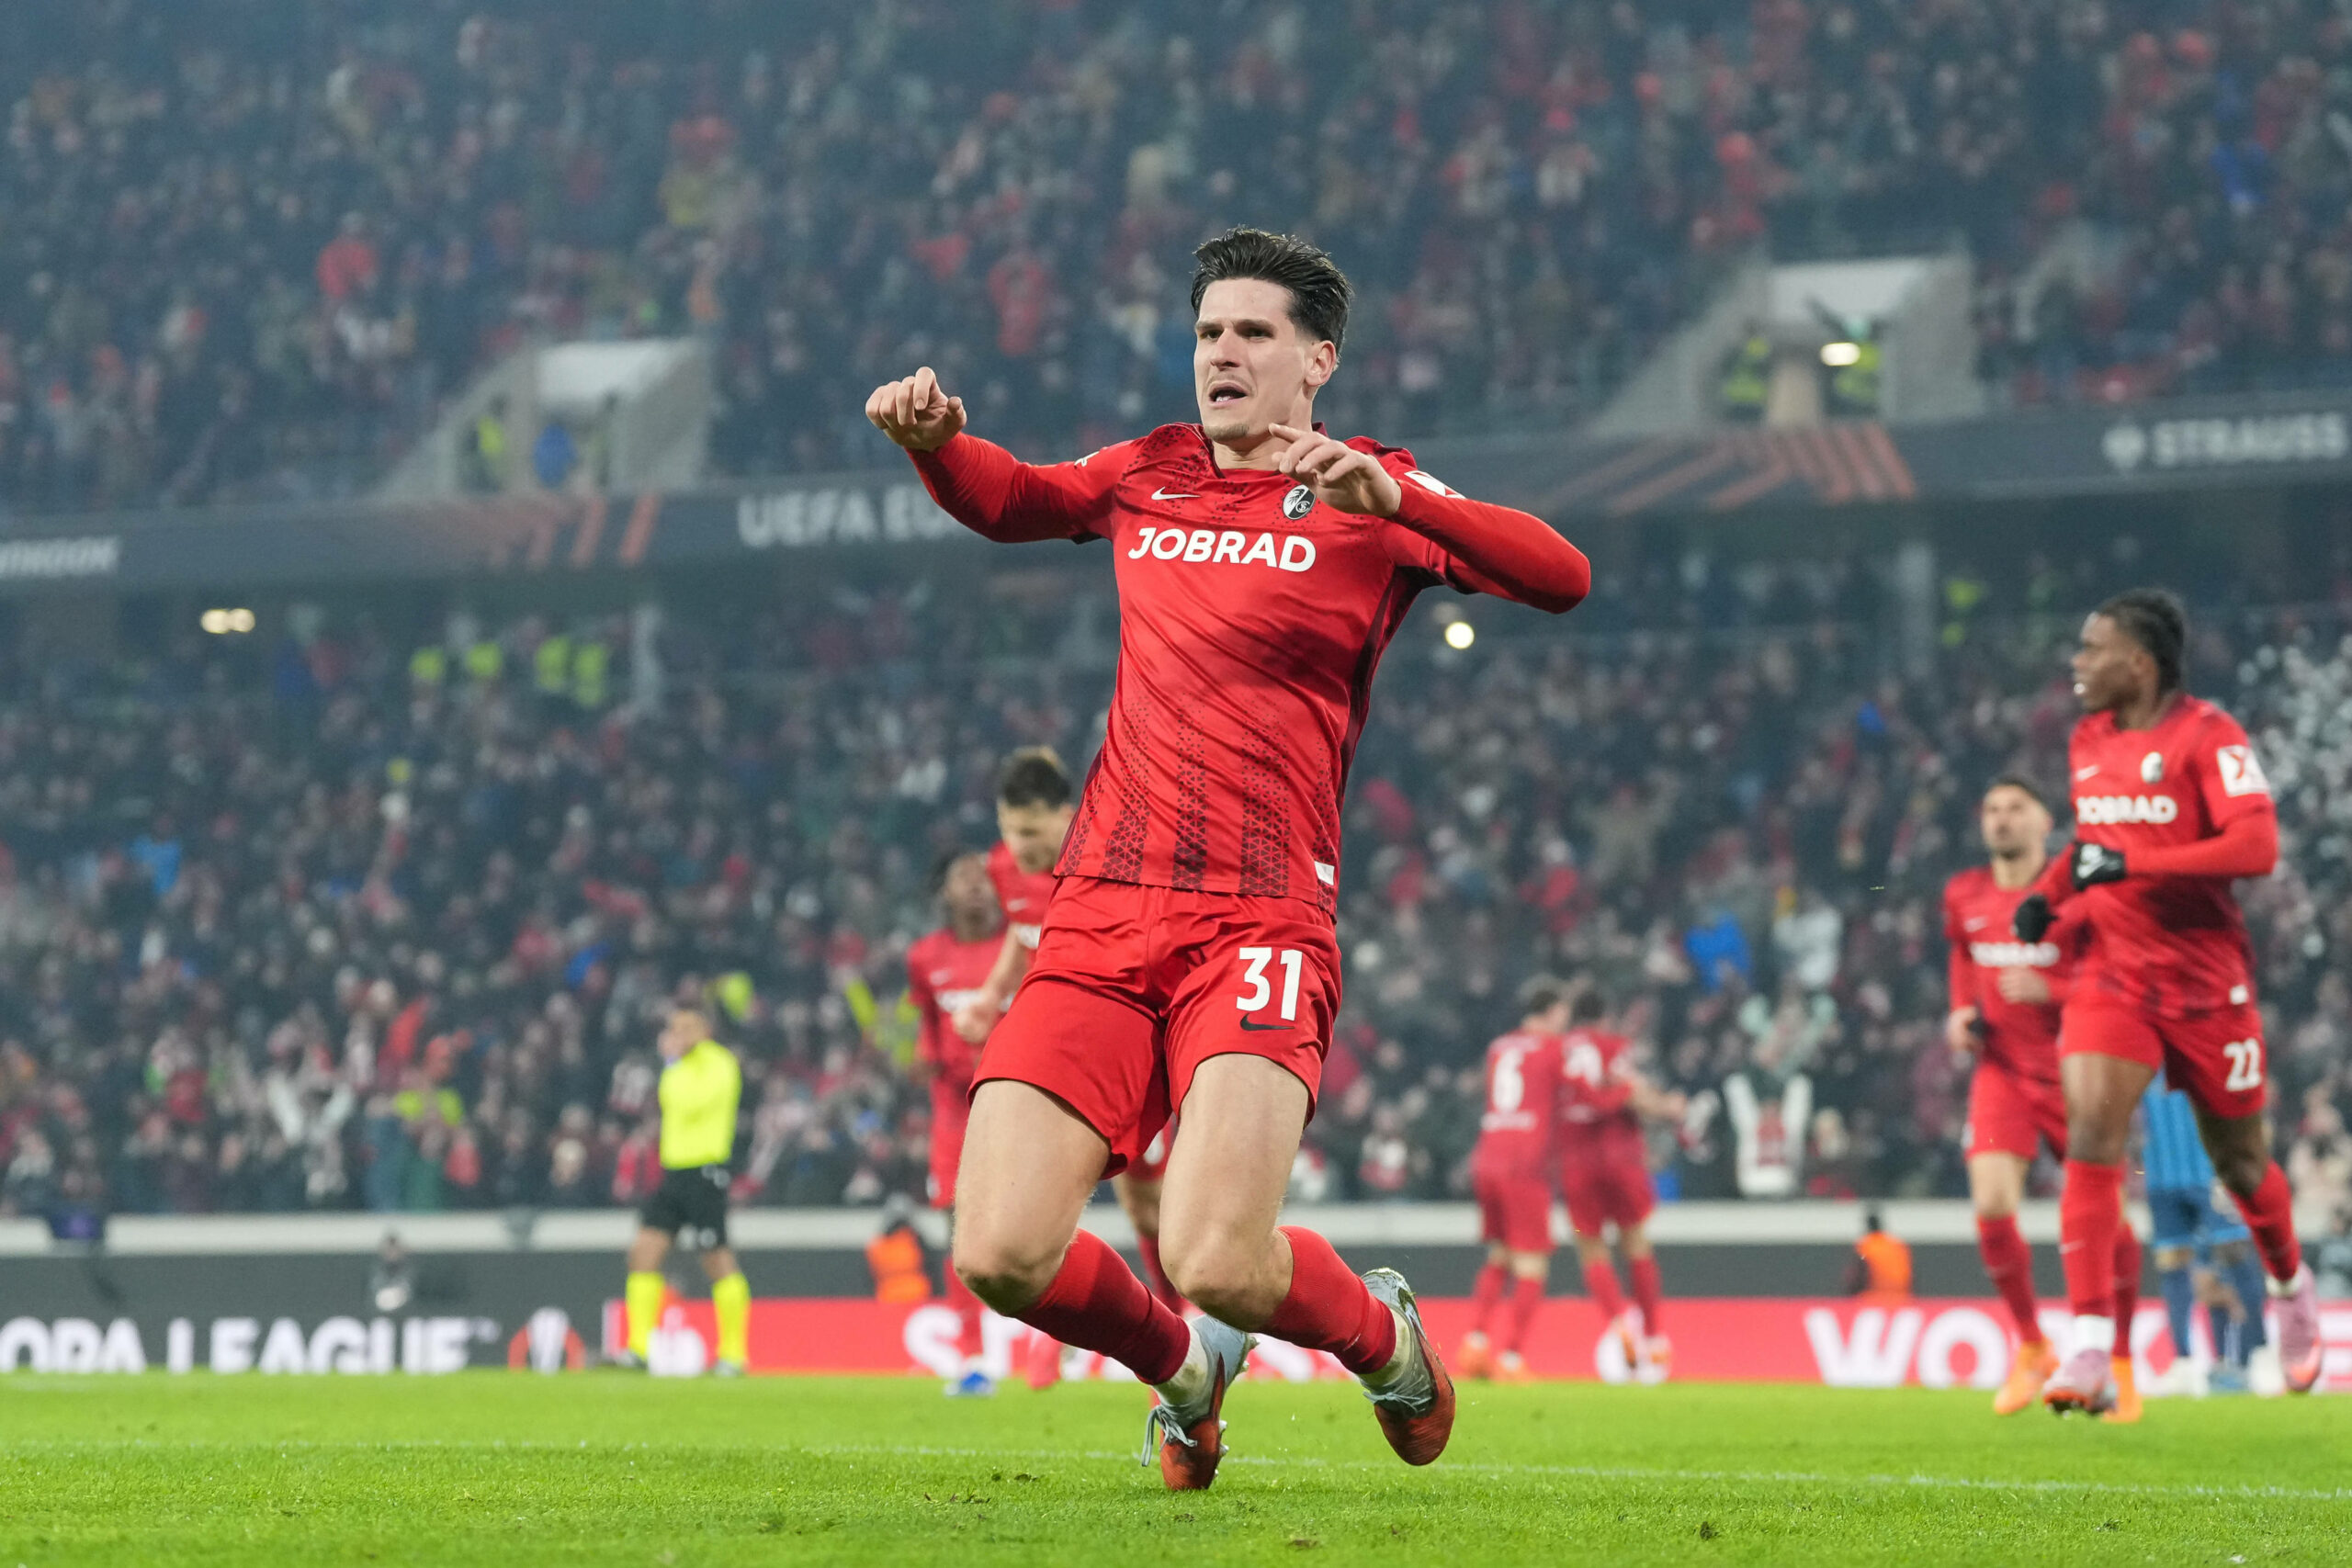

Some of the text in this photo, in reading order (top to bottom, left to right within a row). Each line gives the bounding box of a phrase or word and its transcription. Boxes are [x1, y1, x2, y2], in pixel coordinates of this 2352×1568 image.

[737, 490, 876, 548] UEFA
[1127, 526, 1317, 573] JOBRAD
[1236, 946, 1303, 1022] 31
[2222, 1037, 2262, 1093] 22
